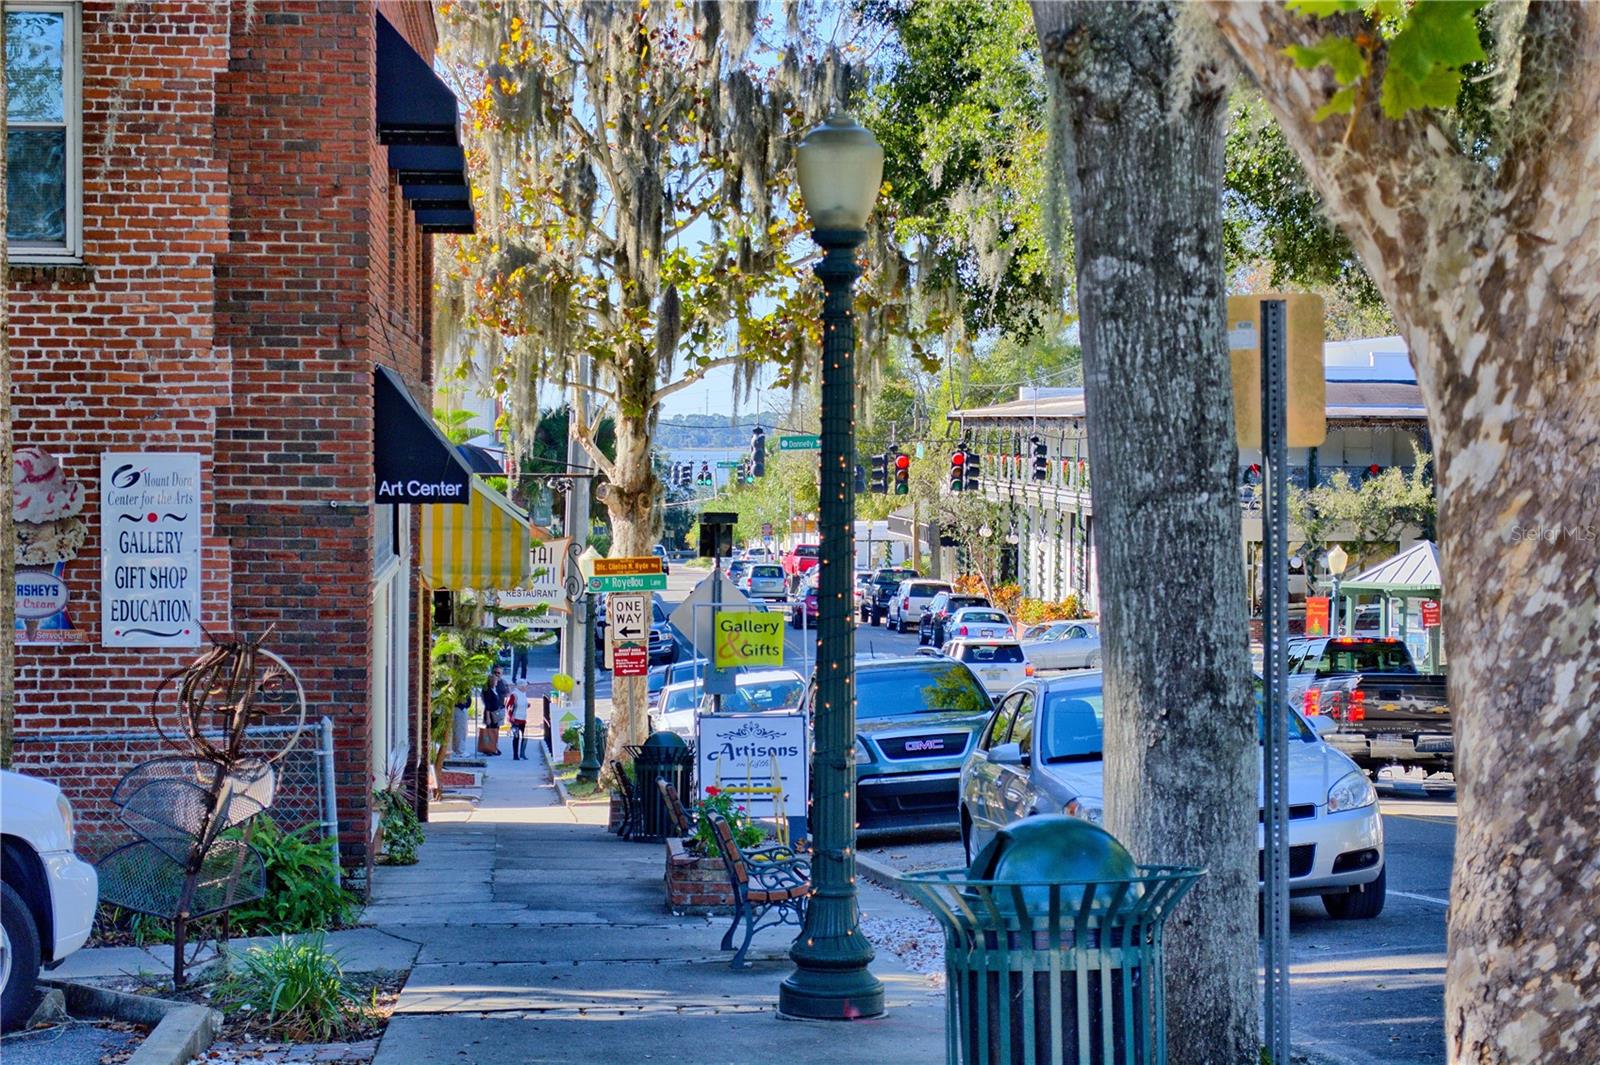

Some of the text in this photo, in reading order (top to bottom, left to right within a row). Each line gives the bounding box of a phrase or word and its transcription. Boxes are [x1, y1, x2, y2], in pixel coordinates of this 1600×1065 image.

[788, 439, 814, 448] Donnelly
[144, 472, 193, 487] Mount Dora
[379, 480, 462, 496] Art Center
[107, 490, 193, 510] Center for the Arts
[119, 531, 183, 554] GALLERY
[115, 566, 188, 589] GIFT SHOP
[612, 577, 644, 589] Royellou
[16, 584, 59, 597] RSHEY'S
[506, 589, 558, 598] RESTAURANT
[23, 598, 56, 609] Cream
[110, 599, 191, 622] EDUCATION
[616, 601, 641, 612] ONE
[616, 613, 641, 624] WAY
[720, 620, 779, 635] Gallery
[718, 630, 779, 660] & Gifts
[905, 739, 944, 751] GMC
